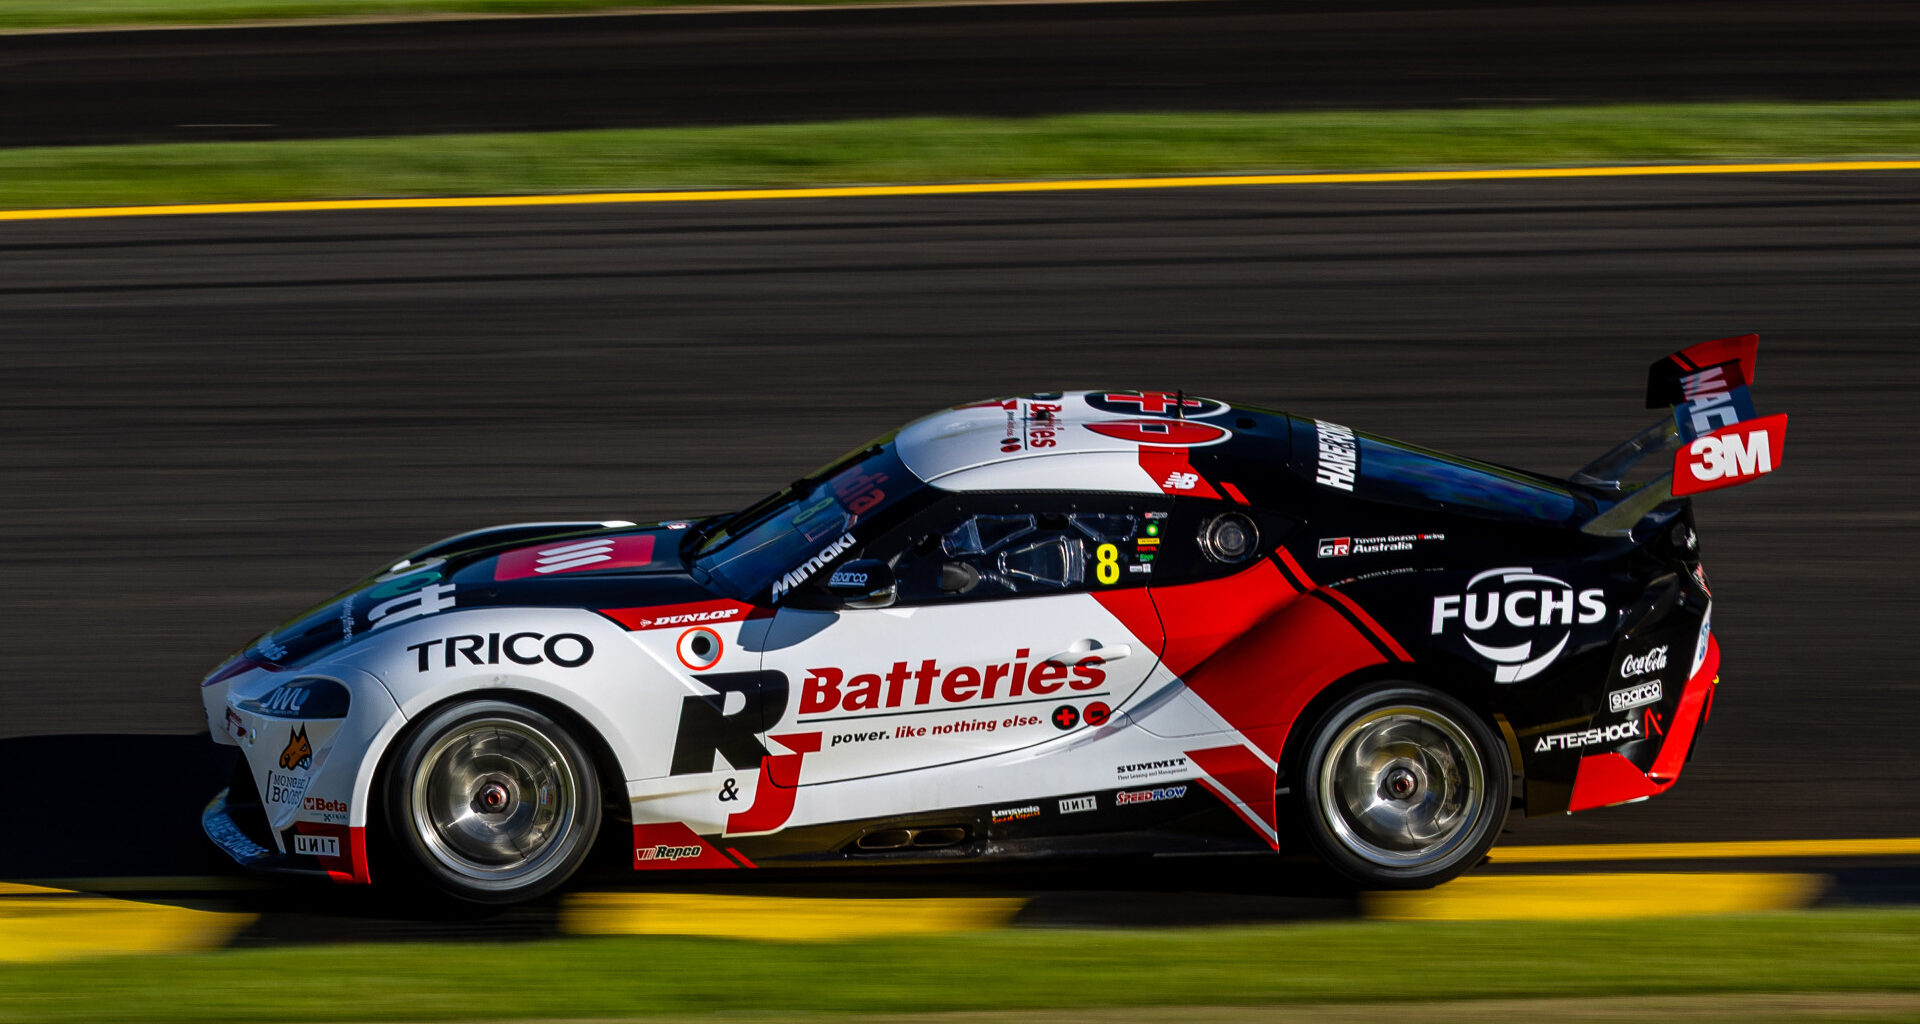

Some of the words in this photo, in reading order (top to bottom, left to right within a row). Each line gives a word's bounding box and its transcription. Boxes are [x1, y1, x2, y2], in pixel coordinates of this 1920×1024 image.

[1680, 366, 1740, 438] MAC
[1689, 429, 1772, 481] 3M
[1319, 544, 1348, 556] GR
[1353, 541, 1413, 554] Australia
[1096, 543, 1120, 585] 8
[829, 572, 868, 587] sparco
[653, 608, 740, 626] DUNLOP
[1431, 588, 1607, 636] FUCHS
[406, 631, 595, 673] TRICO
[797, 647, 1107, 715] Batteries
[1612, 683, 1660, 710] sparco
[831, 730, 890, 747] power.
[894, 726, 927, 739] like
[932, 717, 997, 736] nothing
[1002, 715, 1043, 729] else.
[1534, 719, 1641, 753] AFTERSHOCK
[1117, 757, 1187, 774] SUMMIT
[717, 777, 740, 803] &
[1115, 785, 1188, 806] SPEEDFLOW
[315, 797, 348, 813] Beta
[991, 805, 1040, 817] Lansvale
[297, 837, 336, 854] UNIT
[653, 844, 702, 861] Repco
